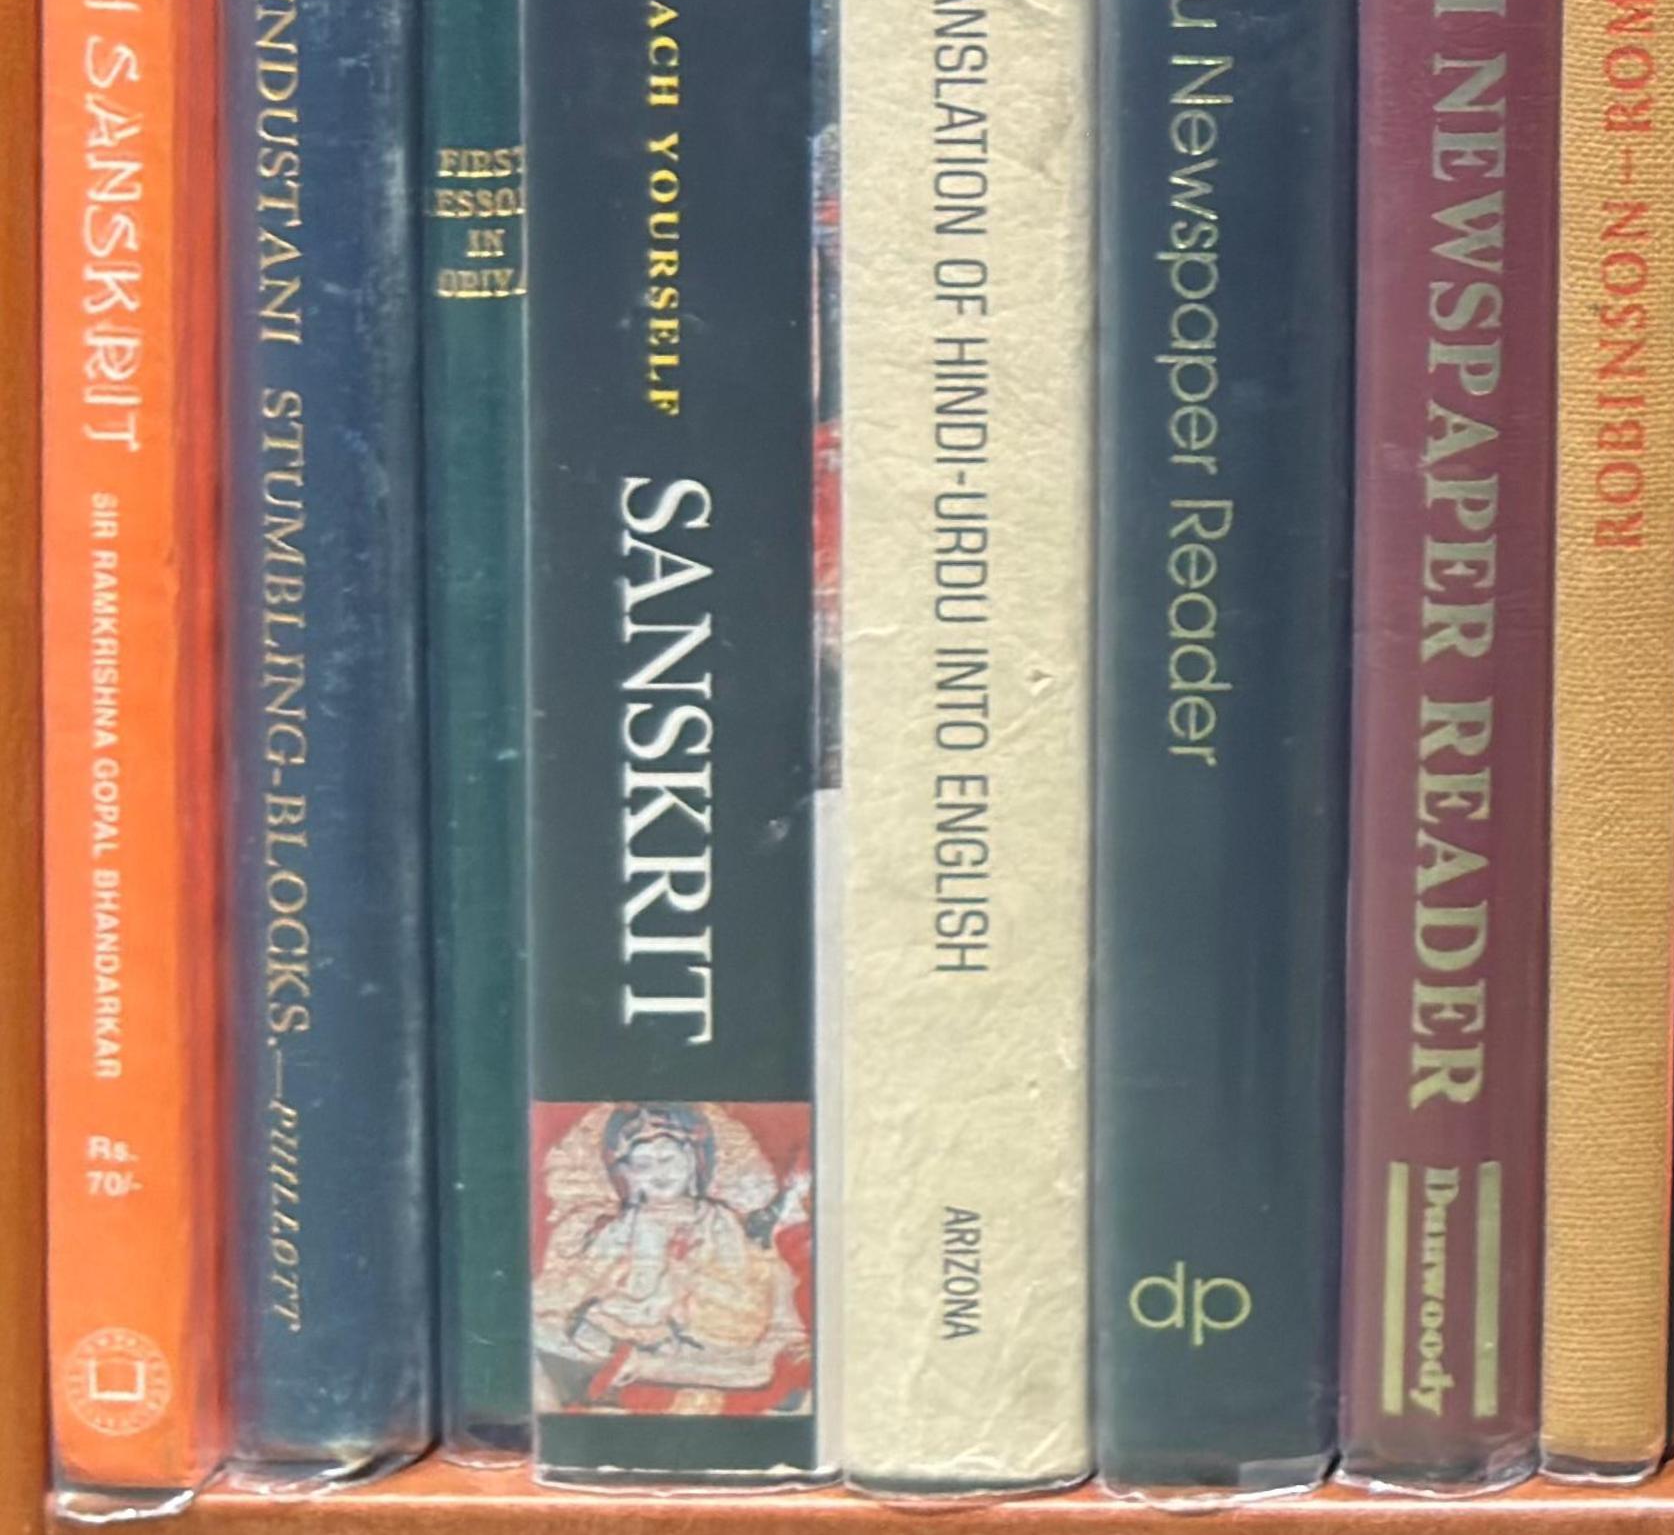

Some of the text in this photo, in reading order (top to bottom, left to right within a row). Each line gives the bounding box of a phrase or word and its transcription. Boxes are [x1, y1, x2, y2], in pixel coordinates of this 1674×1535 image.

[84, 34, 142, 454] SANSKRIT
[420, 186, 526, 216] ESSO
[466, 228, 506, 258] IN
[645, 132, 680, 416] YOURSELF
[932, 256, 988, 318] OF
[1155, 56, 1236, 476] Newspaper
[932, 338, 988, 626] HINDI-URDU
[1418, 51, 1510, 664] NEWSPAPER
[1594, 196, 1652, 552] ROBINSON
[620, 476, 715, 1044] SANSKRIT
[932, 646, 988, 751] INTO
[1166, 499, 1235, 766] Reader
[90, 492, 122, 1080] SIR RAMKRISHNA GOPAL BHANDARKAR
[935, 776, 988, 976] ENGLISH
[1408, 694, 1495, 1111] READER
[85, 1170, 143, 1197] 70/-
[86, 1135, 140, 1162] Rs.
[940, 1206, 983, 1342] ARIZONA
[1128, 1261, 1252, 1346] dp
[1408, 1166, 1461, 1417] Dunwoody
